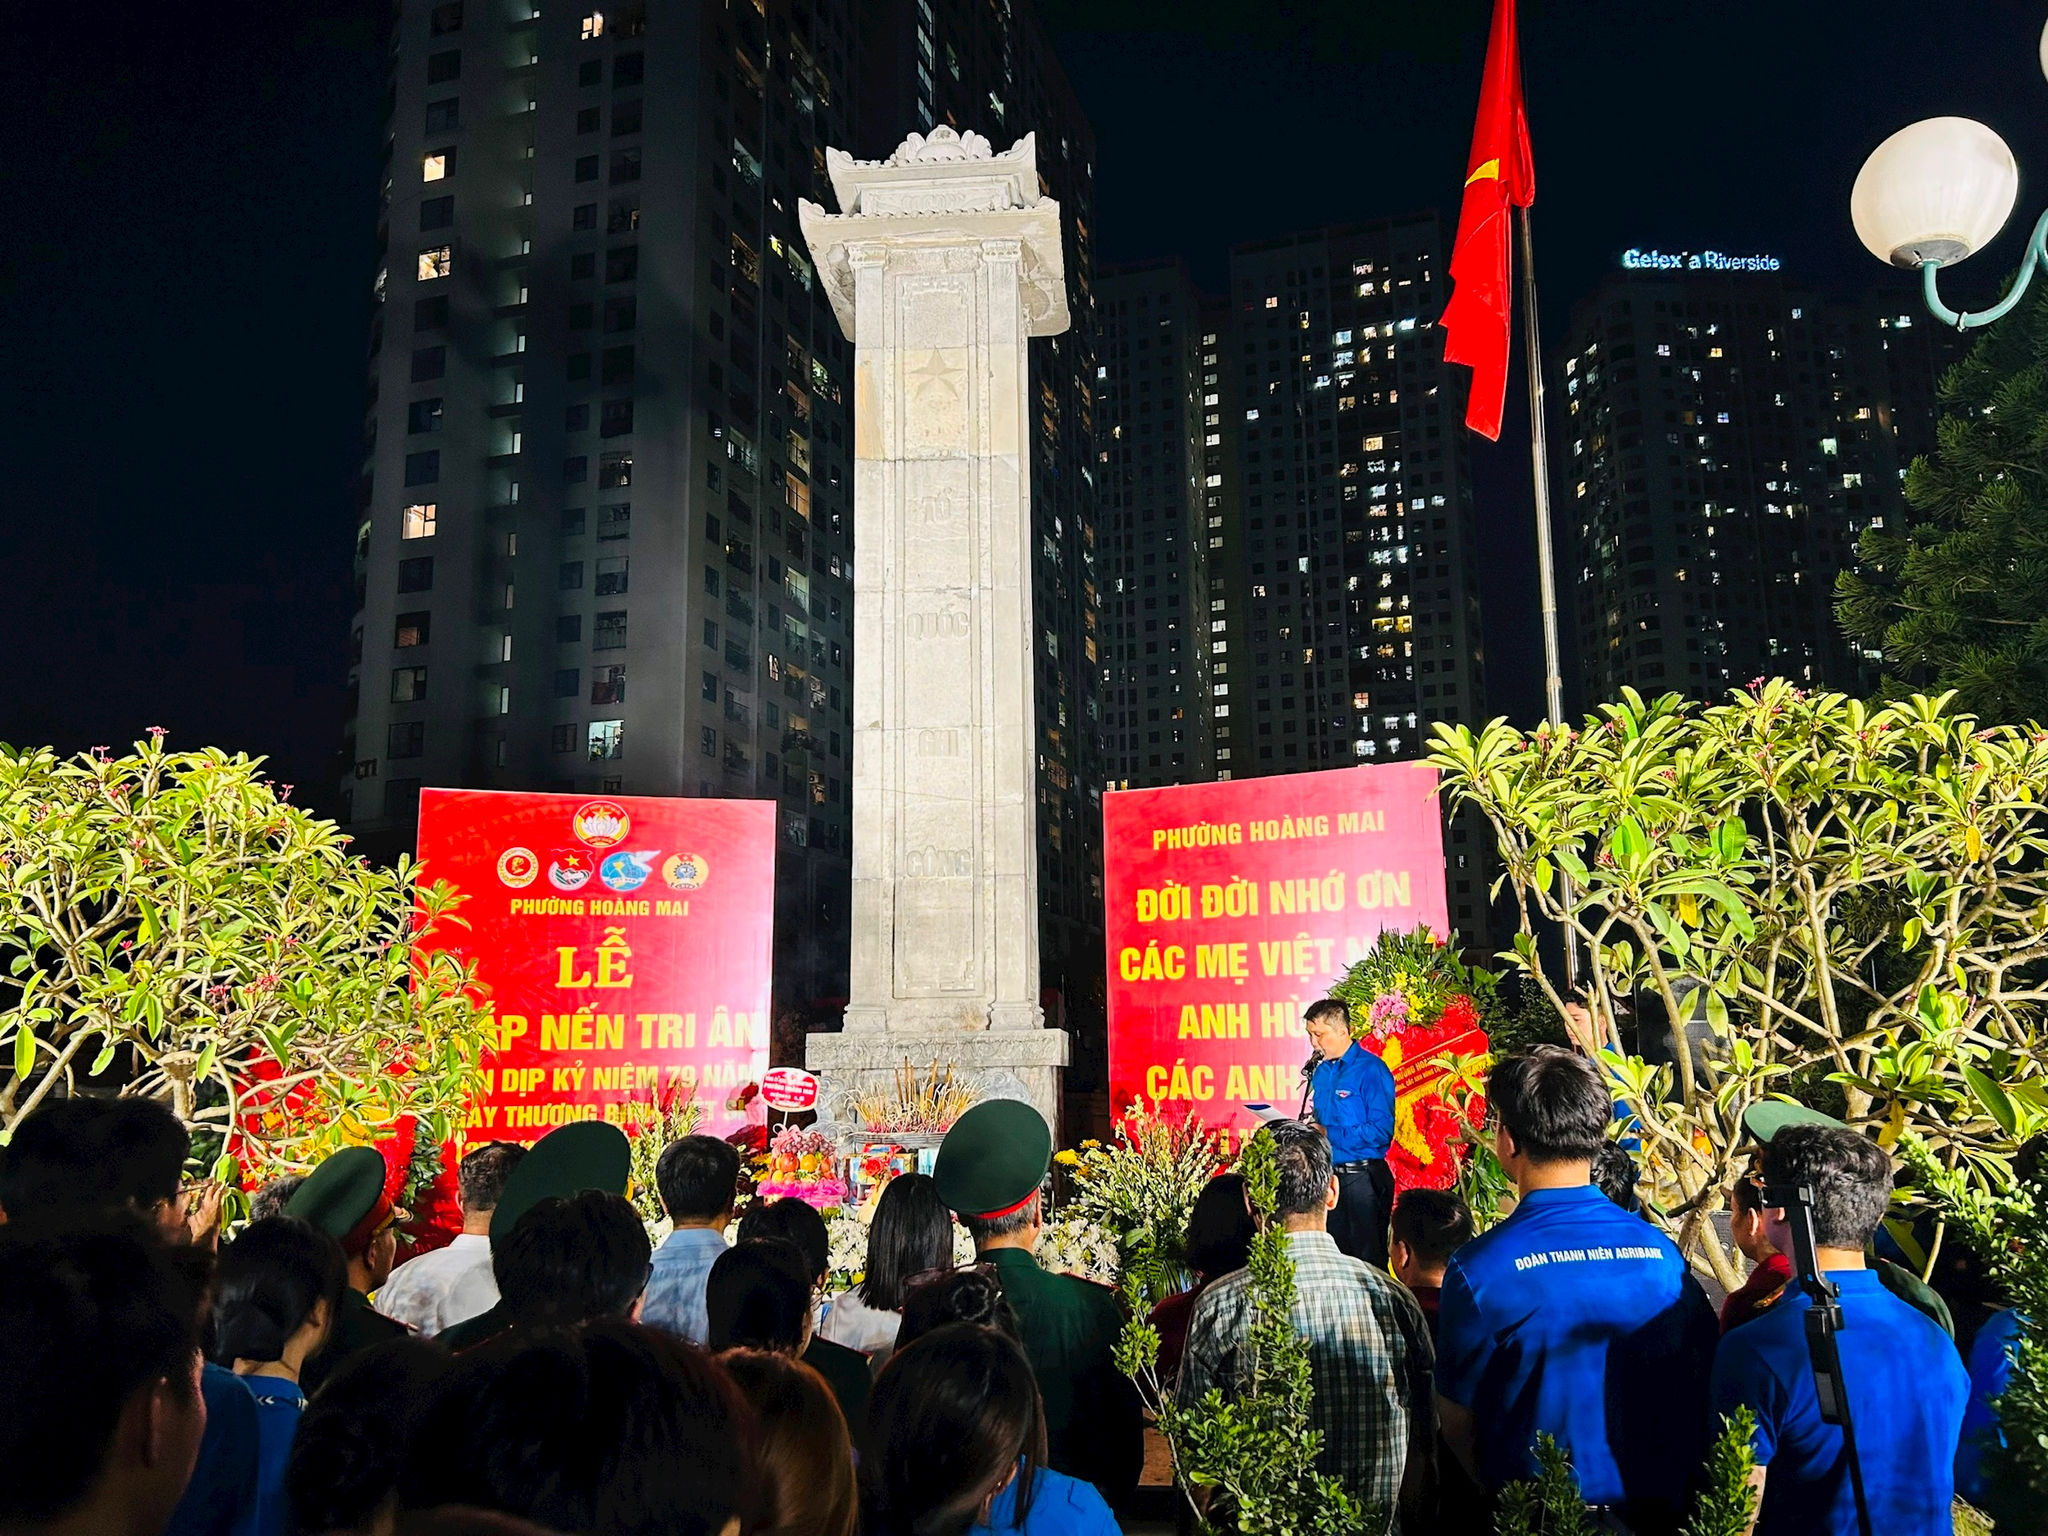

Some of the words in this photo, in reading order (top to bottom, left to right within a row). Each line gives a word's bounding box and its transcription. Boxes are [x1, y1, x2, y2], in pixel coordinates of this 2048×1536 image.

[1705, 250, 1780, 271] Riverside
[906, 602, 969, 638] QUỐC
[918, 729, 960, 757] GHI
[1152, 821, 1242, 850] PHƯỜNG
[1249, 814, 1329, 842] HOÀNG
[1337, 810, 1385, 834] MAI
[905, 844, 971, 878] CÔNG
[510, 896, 584, 915] PHƯỜNG
[590, 897, 650, 916] HOÀNG
[655, 901, 689, 916] MAI
[1136, 879, 1191, 922] ĐỜI
[1200, 875, 1259, 918] ĐỜI
[1269, 869, 1346, 915] NHỚ
[1356, 869, 1411, 909] ƠN
[554, 926, 634, 988] LỄ
[1119, 940, 1186, 981] CÁC
[1196, 943, 1249, 985] MẸ
[1258, 932, 1335, 982] VIỆT
[540, 1002, 625, 1050] NẾN
[636, 1013, 696, 1048] TRI
[706, 1005, 765, 1048] ÂN
[1178, 1003, 1250, 1039] ANH
[1260, 994, 1308, 1039] HÙ
[502, 1068, 546, 1097] DỊP
[552, 1060, 586, 1092] KỶ
[592, 1062, 659, 1095] NIỆM
[665, 1065, 696, 1089] 79
[1146, 1058, 1214, 1100] CÁC
[1225, 1065, 1300, 1101] ANH
[504, 1101, 599, 1128] THƯƠNG
[1515, 1253, 1549, 1271] ĐOÀN
[1549, 1250, 1586, 1263] THANH
[1587, 1246, 1614, 1260] NIÊN
[1615, 1246, 1663, 1261] AGRIBANK
